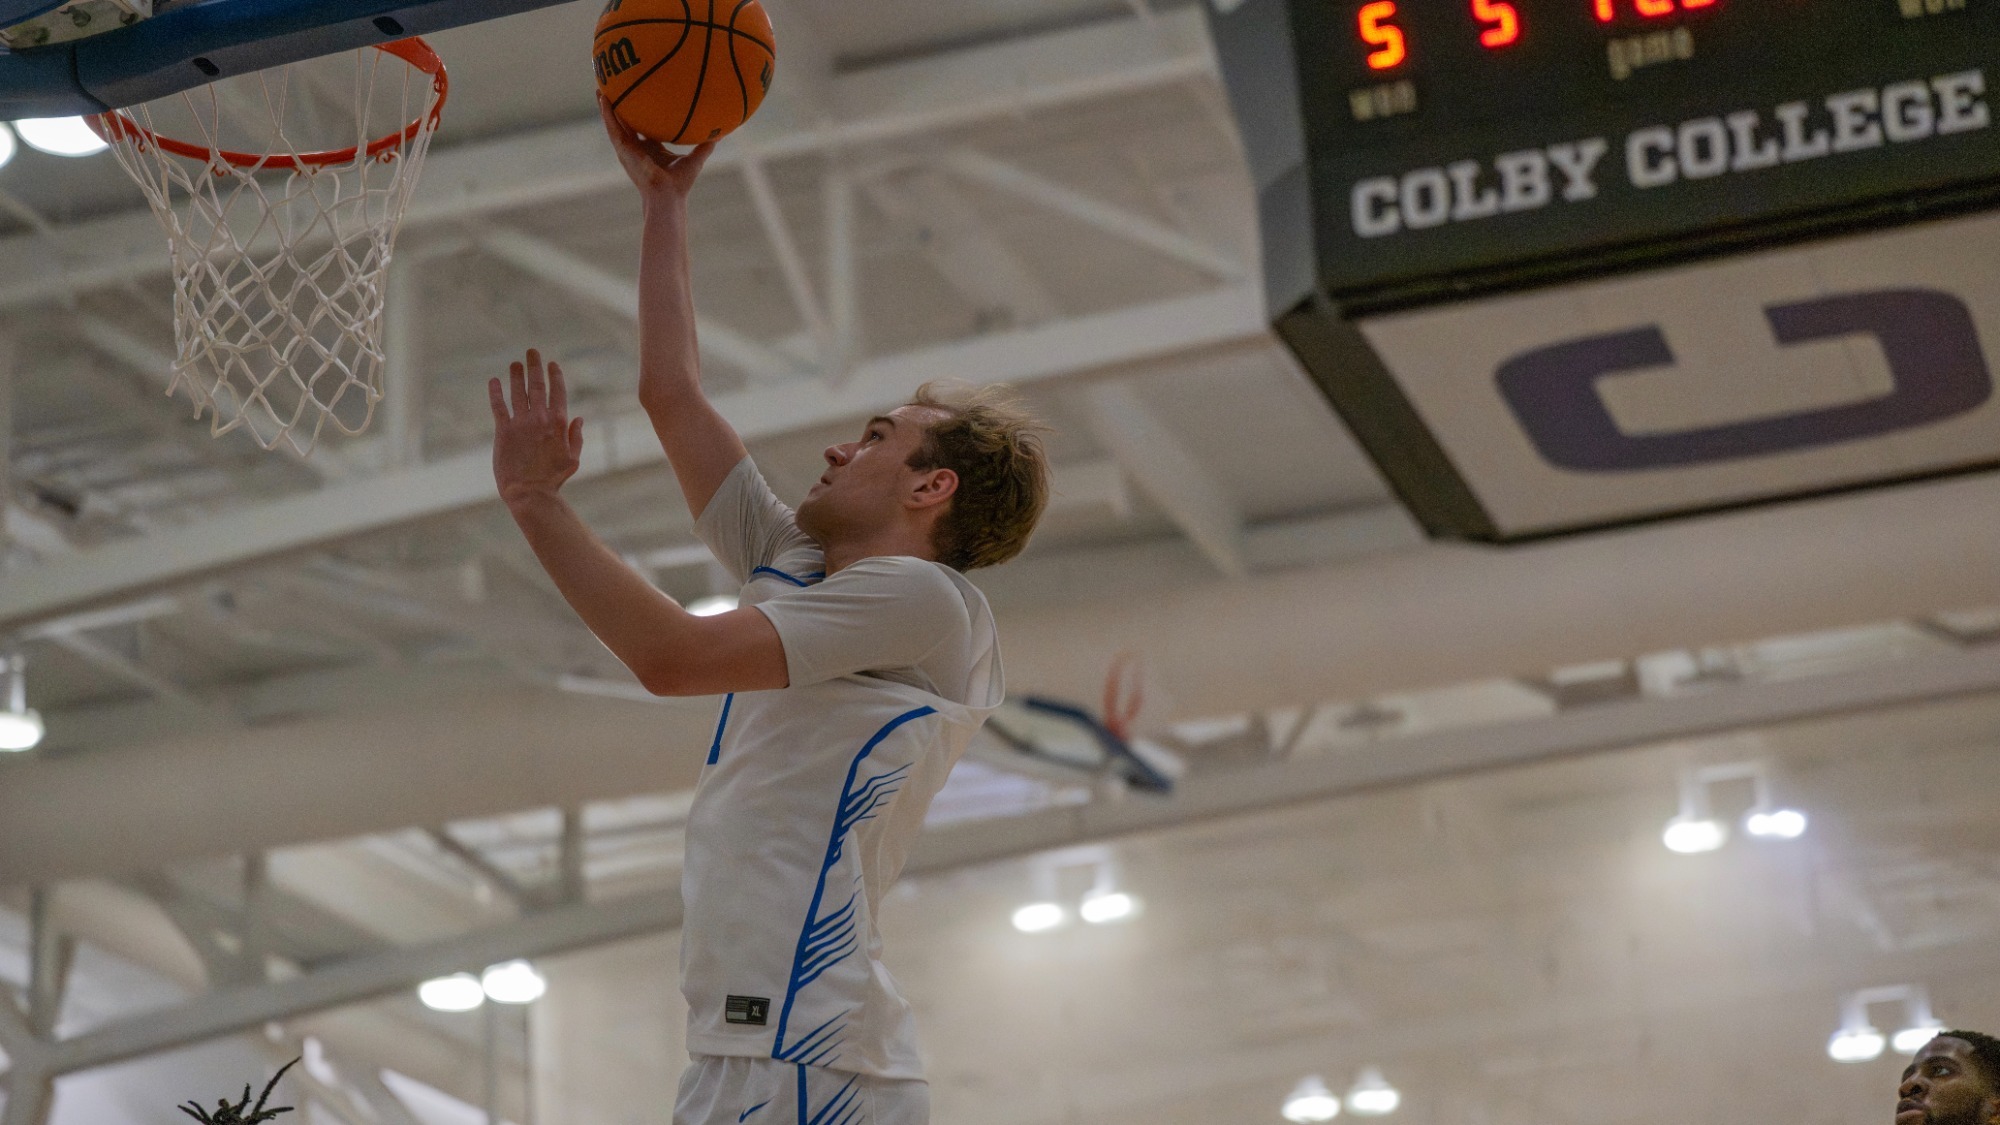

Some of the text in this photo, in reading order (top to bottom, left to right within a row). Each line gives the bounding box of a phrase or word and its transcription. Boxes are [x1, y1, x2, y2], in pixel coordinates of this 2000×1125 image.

[1359, 1, 1405, 69] 5
[1351, 71, 1989, 237] COLBY COLLEGE
[751, 1005, 761, 1017] XL
